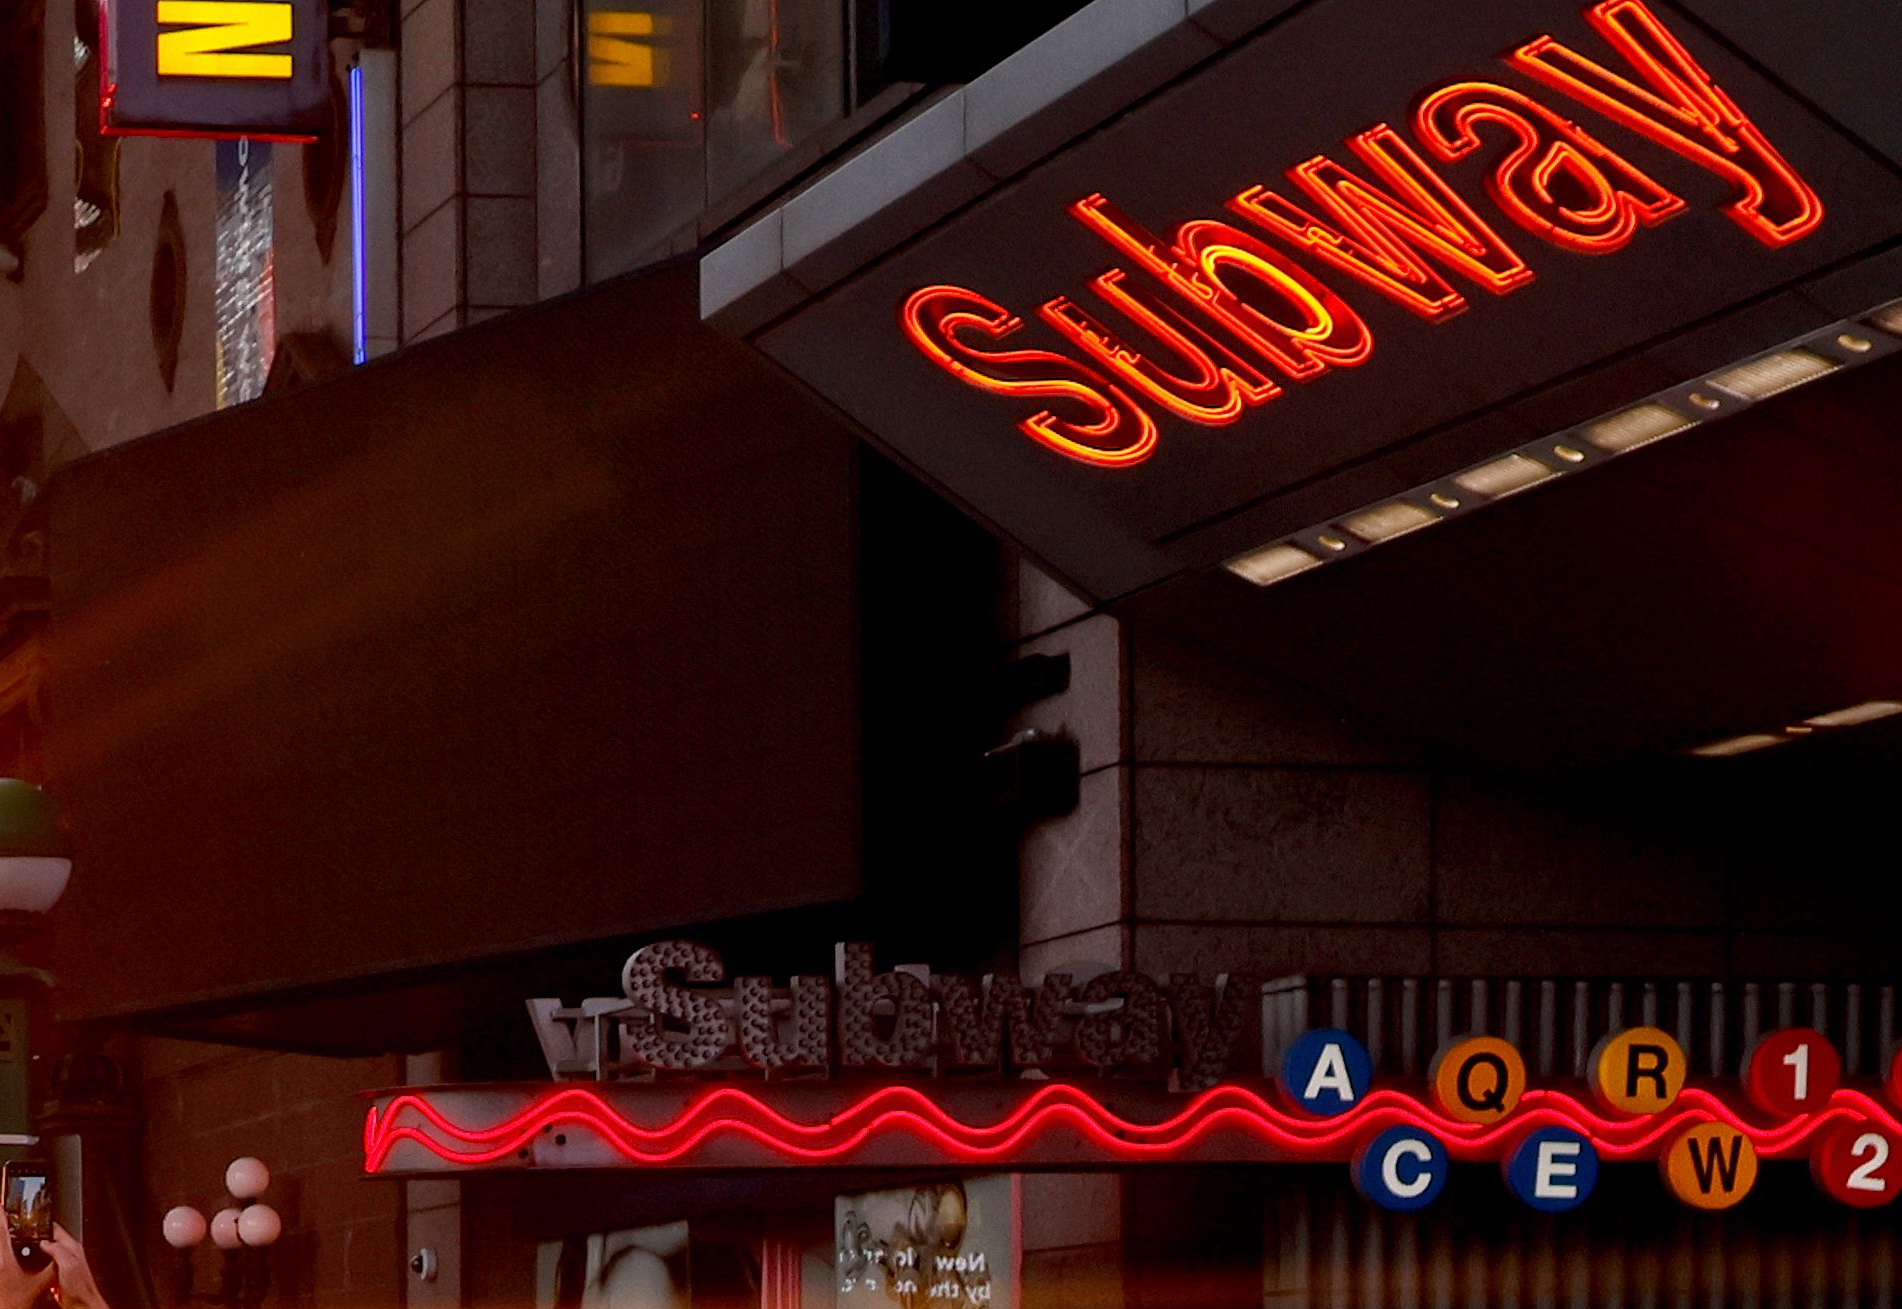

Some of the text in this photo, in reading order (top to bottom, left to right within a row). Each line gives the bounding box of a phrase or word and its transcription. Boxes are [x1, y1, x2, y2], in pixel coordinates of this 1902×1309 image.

[900, 0, 1825, 468] Subway
[622, 940, 1244, 1092] Subway
[1303, 1044, 1809, 1112] A Q R 1
[1381, 1134, 1890, 1199] C E W 2
